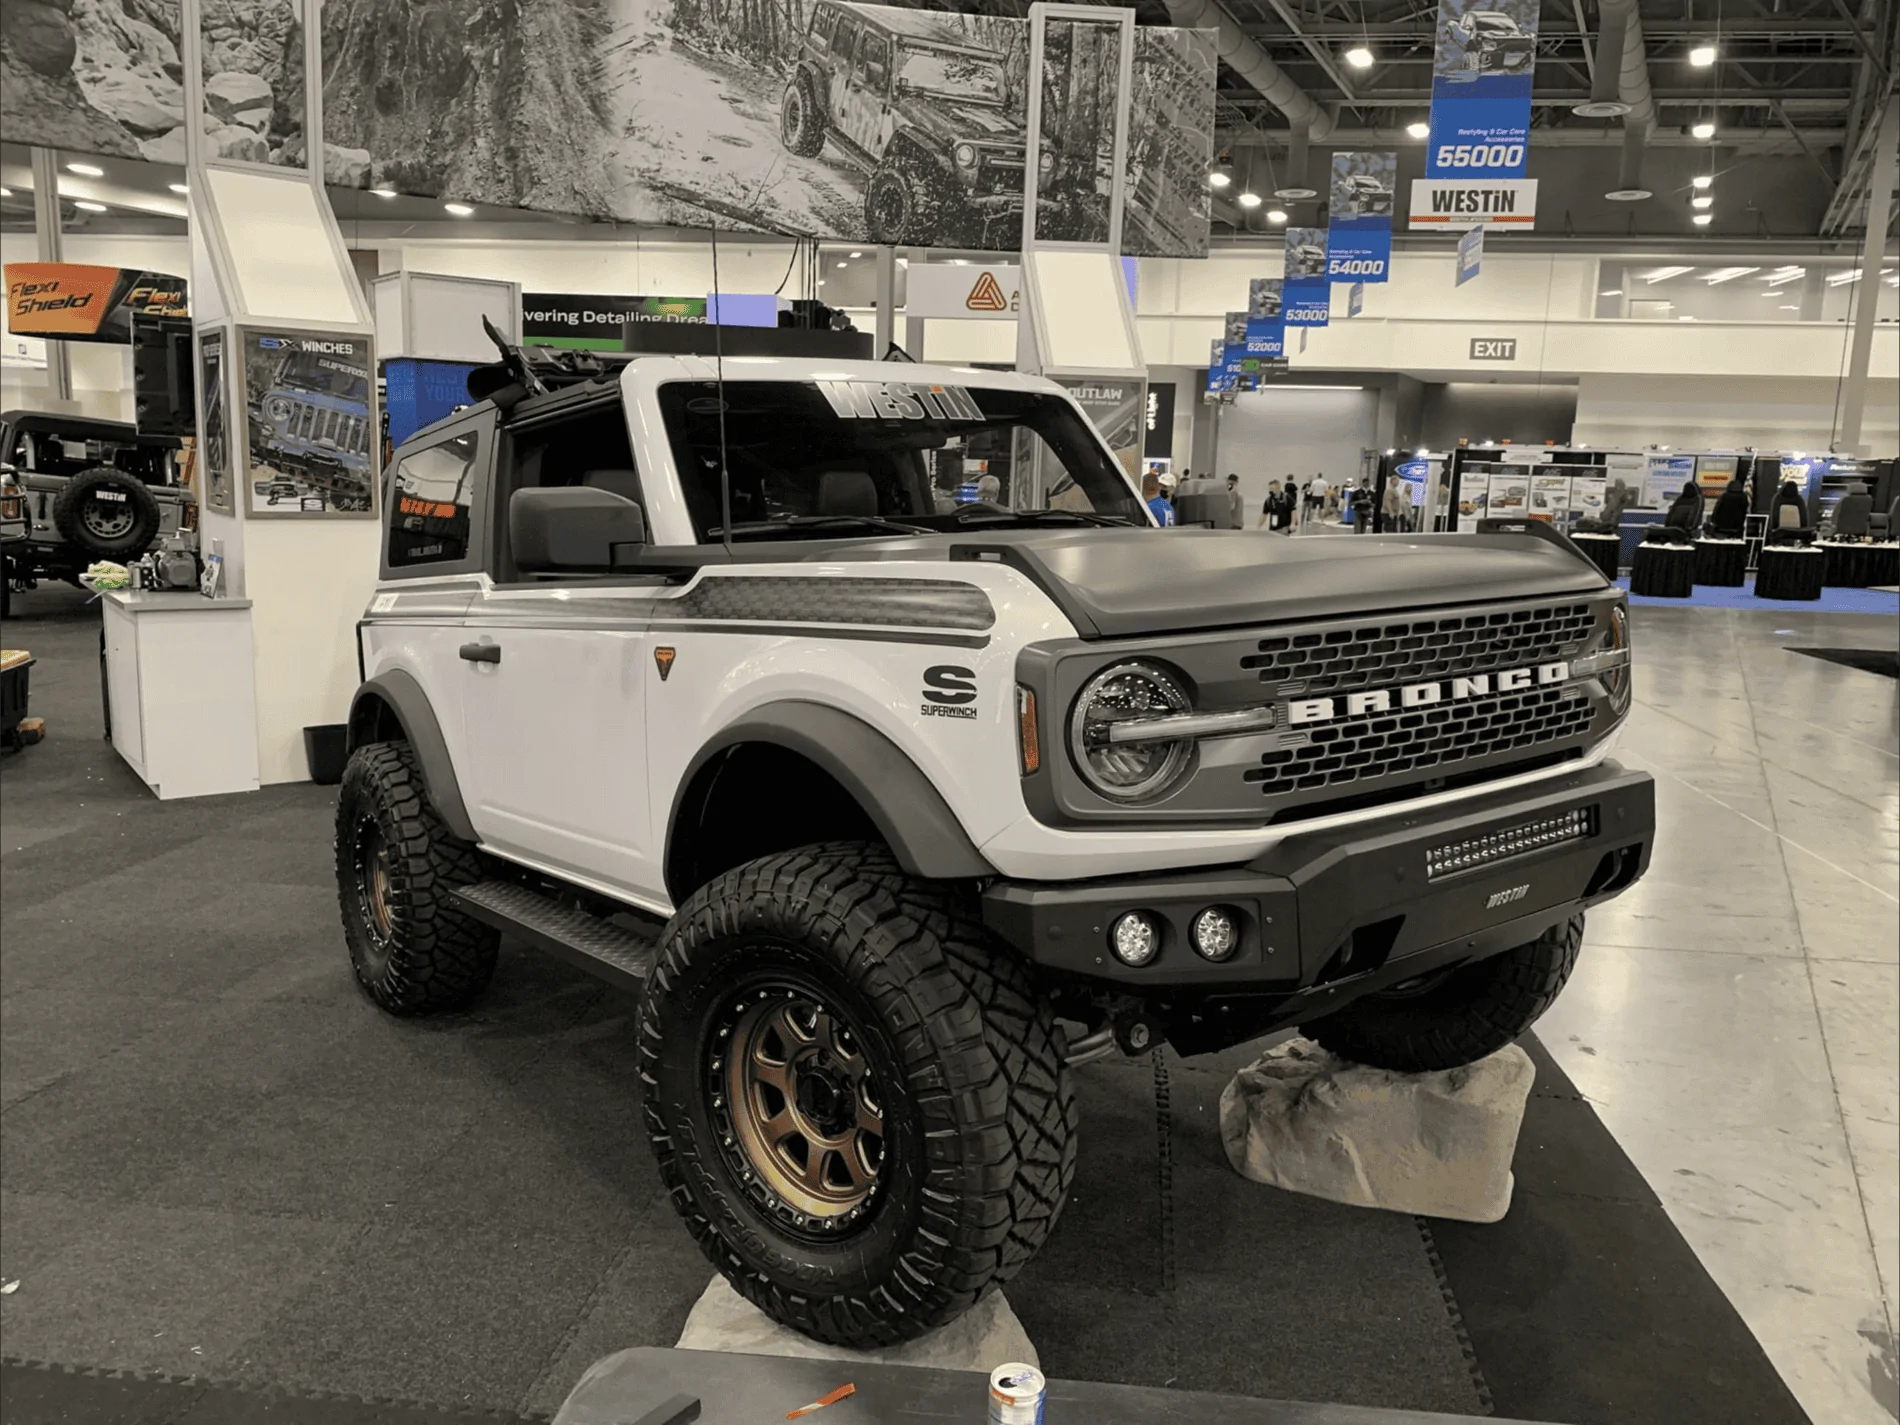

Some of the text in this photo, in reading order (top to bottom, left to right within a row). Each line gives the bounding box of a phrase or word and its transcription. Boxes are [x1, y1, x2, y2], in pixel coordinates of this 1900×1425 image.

[1436, 145, 1524, 168] 55000
[1328, 260, 1385, 275] 54000
[16, 292, 93, 316] Shield
[1286, 309, 1328, 321] 53000
[301, 340, 353, 355] WINCHES
[1247, 342, 1281, 352] 52000
[1474, 341, 1514, 357] EXIT
[1066, 387, 1123, 400] OUTLAW
[1288, 661, 1570, 725] BRONCO
[920, 704, 978, 720] SUPERWINCH
